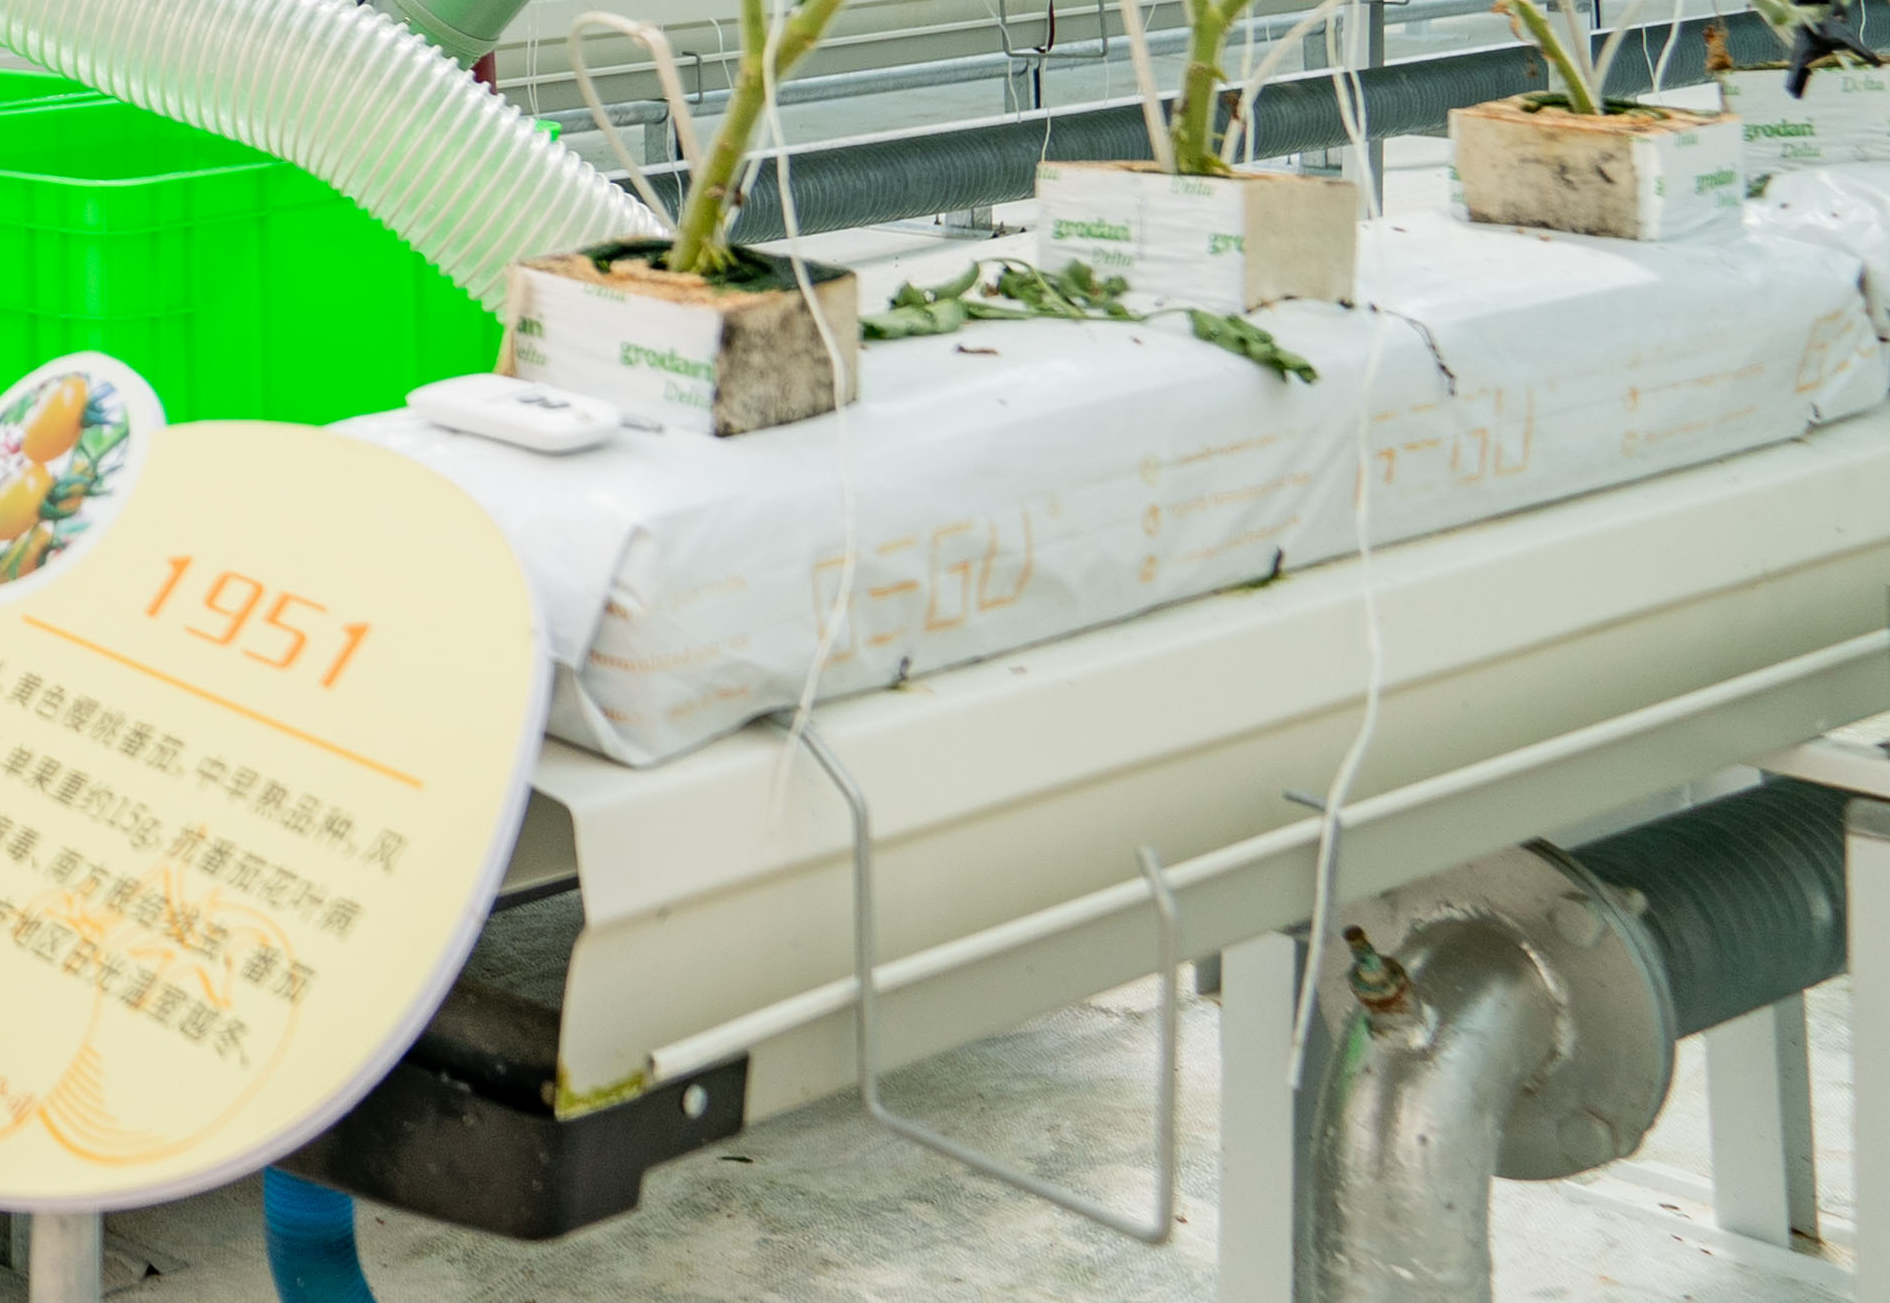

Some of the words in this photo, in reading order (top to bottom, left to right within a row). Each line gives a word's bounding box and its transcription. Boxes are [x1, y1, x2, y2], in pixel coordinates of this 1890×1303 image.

[1741, 117, 1818, 143] grodan
[1052, 216, 1132, 242] grodan
[143, 553, 372, 690] 1951
[811, 506, 1035, 671] GEGU
